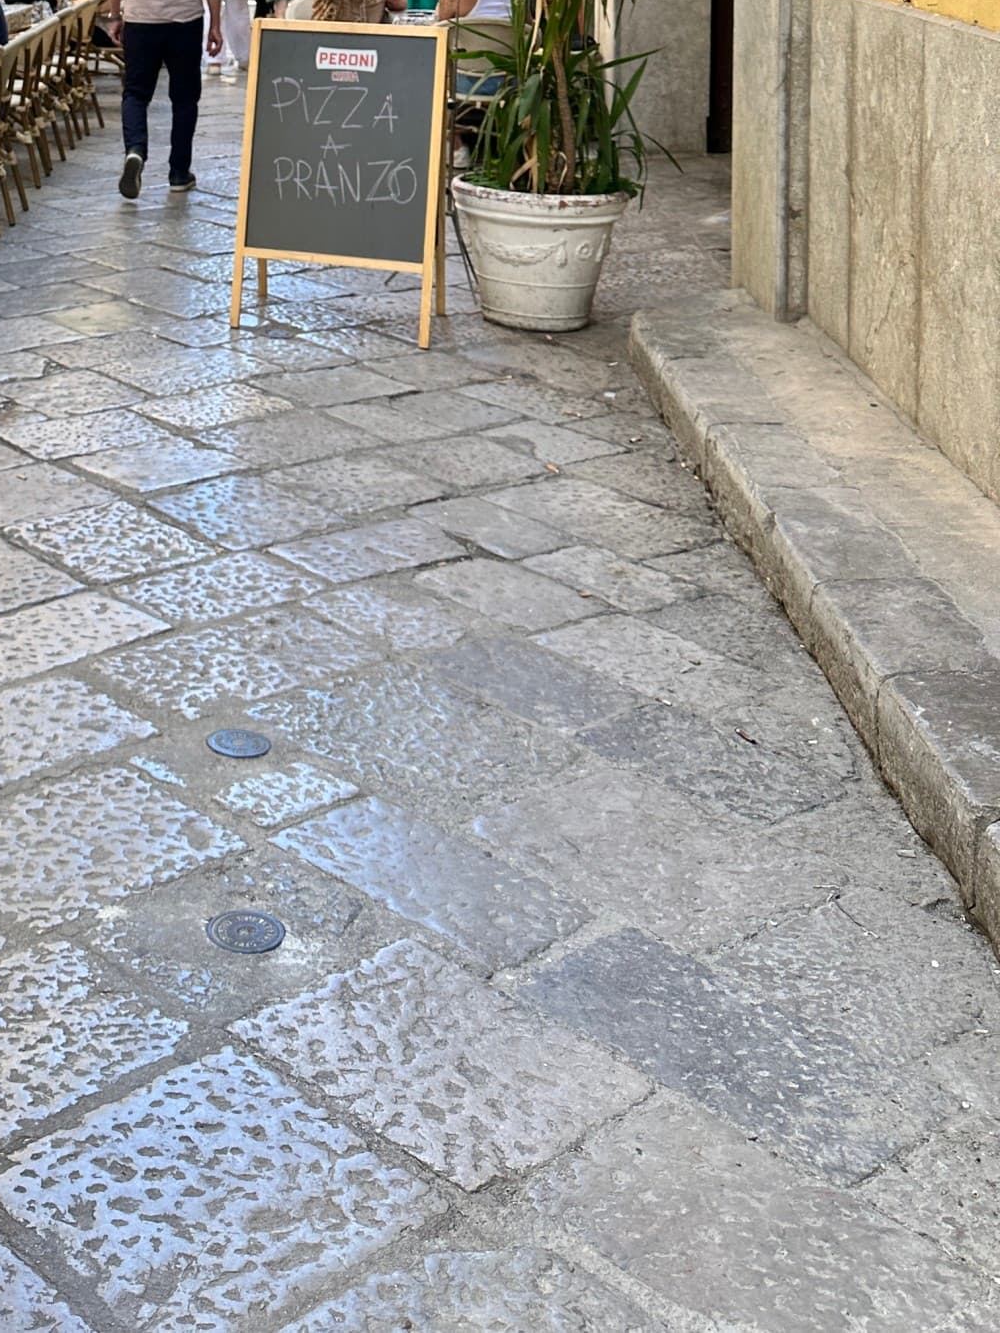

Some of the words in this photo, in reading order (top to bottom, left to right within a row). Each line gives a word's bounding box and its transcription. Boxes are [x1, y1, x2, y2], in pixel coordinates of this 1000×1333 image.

[319, 52, 375, 68] PERONI
[319, 133, 352, 159] A
[273, 156, 418, 207] PRANZO
